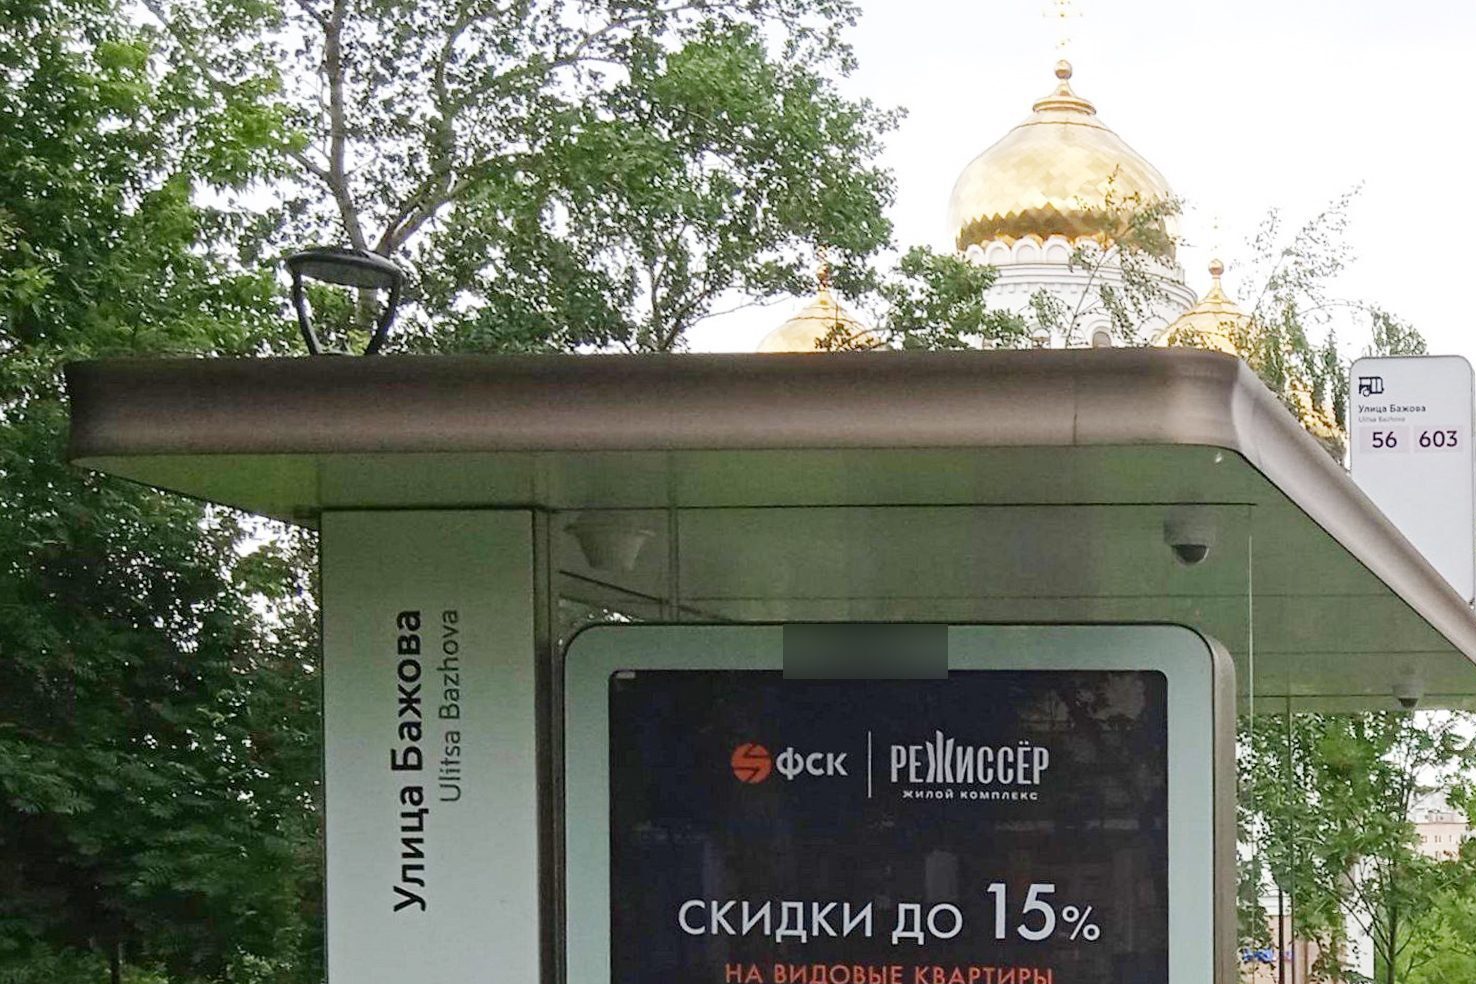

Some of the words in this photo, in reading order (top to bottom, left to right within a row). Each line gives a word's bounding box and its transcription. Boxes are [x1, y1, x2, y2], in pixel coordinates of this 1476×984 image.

[1358, 404, 1387, 413] Улица
[1372, 431, 1397, 448] 56
[1419, 430, 1458, 448] 603
[391, 609, 424, 771] Бажова
[437, 608, 460, 720] Bazhova
[438, 729, 461, 802] Ulitsa
[890, 730, 1050, 785] РЕЖИССЁР
[393, 785, 429, 912] Улица
[677, 899, 873, 943] СКИДКИ
[891, 902, 964, 945] ДО
[985, 882, 1101, 942] 15%
[725, 963, 763, 984] НА
